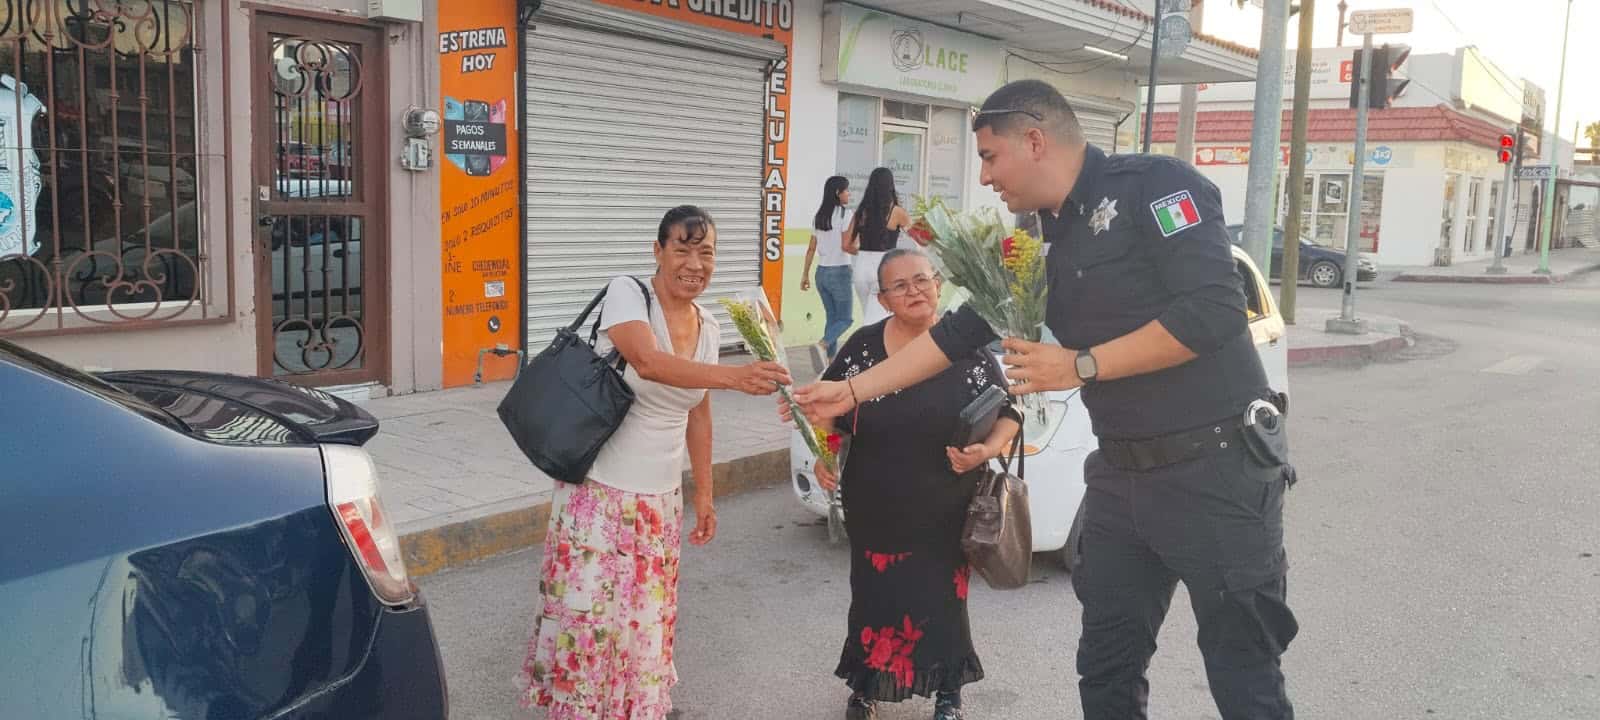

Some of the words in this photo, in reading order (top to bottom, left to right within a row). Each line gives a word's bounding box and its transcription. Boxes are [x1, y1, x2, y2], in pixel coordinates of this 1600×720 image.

[439, 28, 507, 53] ESTRENA
[463, 54, 495, 72] HOY
[925, 46, 968, 73] LACE
[456, 124, 484, 135] PAGOS
[451, 140, 496, 151] SEMANALES
[445, 261, 464, 273] INE
